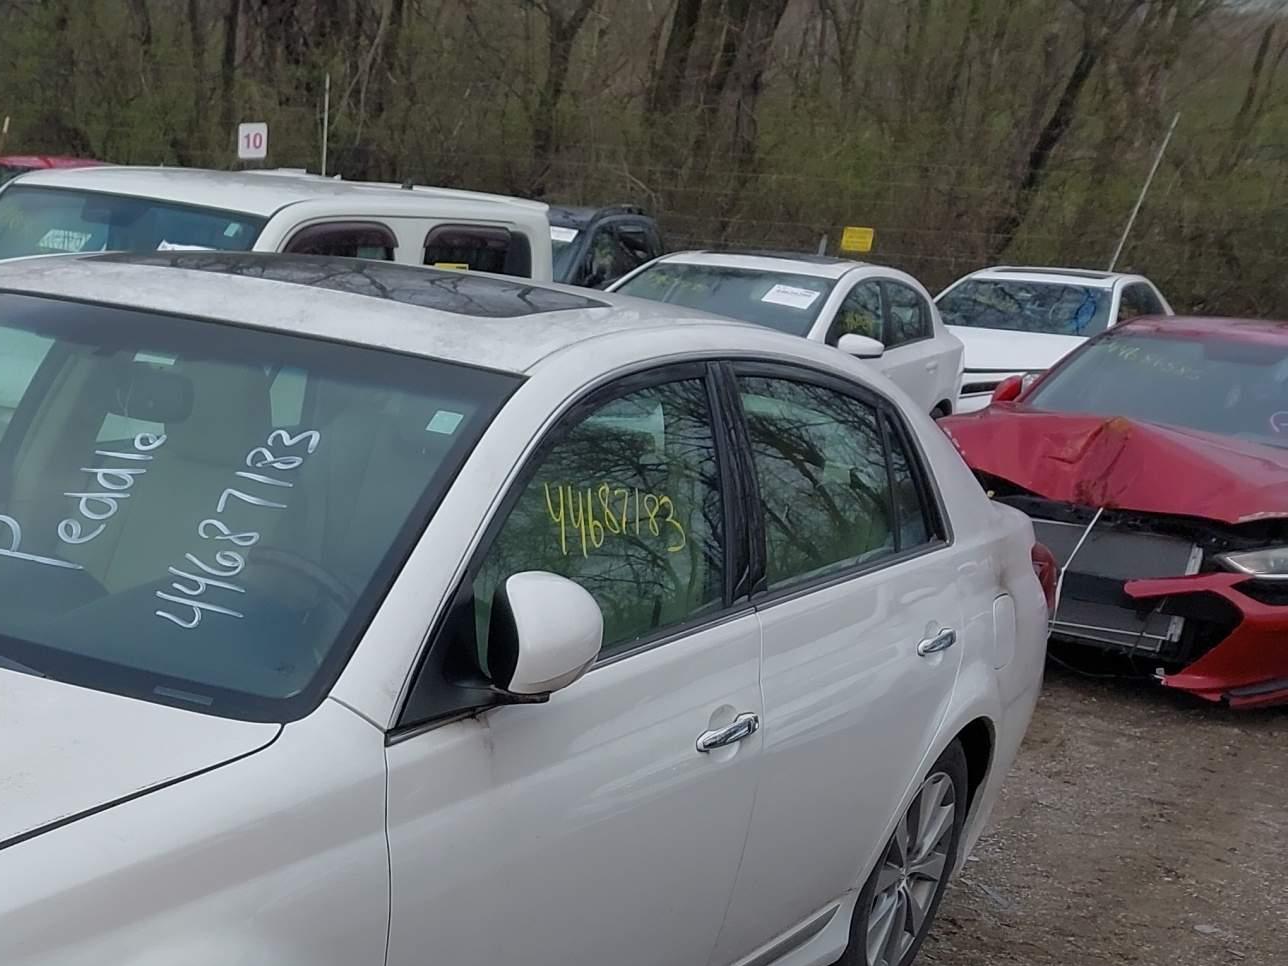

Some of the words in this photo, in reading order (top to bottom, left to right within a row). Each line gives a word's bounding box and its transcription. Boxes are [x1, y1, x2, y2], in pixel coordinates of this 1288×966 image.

[243, 132, 263, 150] 10
[155, 428, 321, 629] 44687183
[544, 481, 687, 559] 44687183
